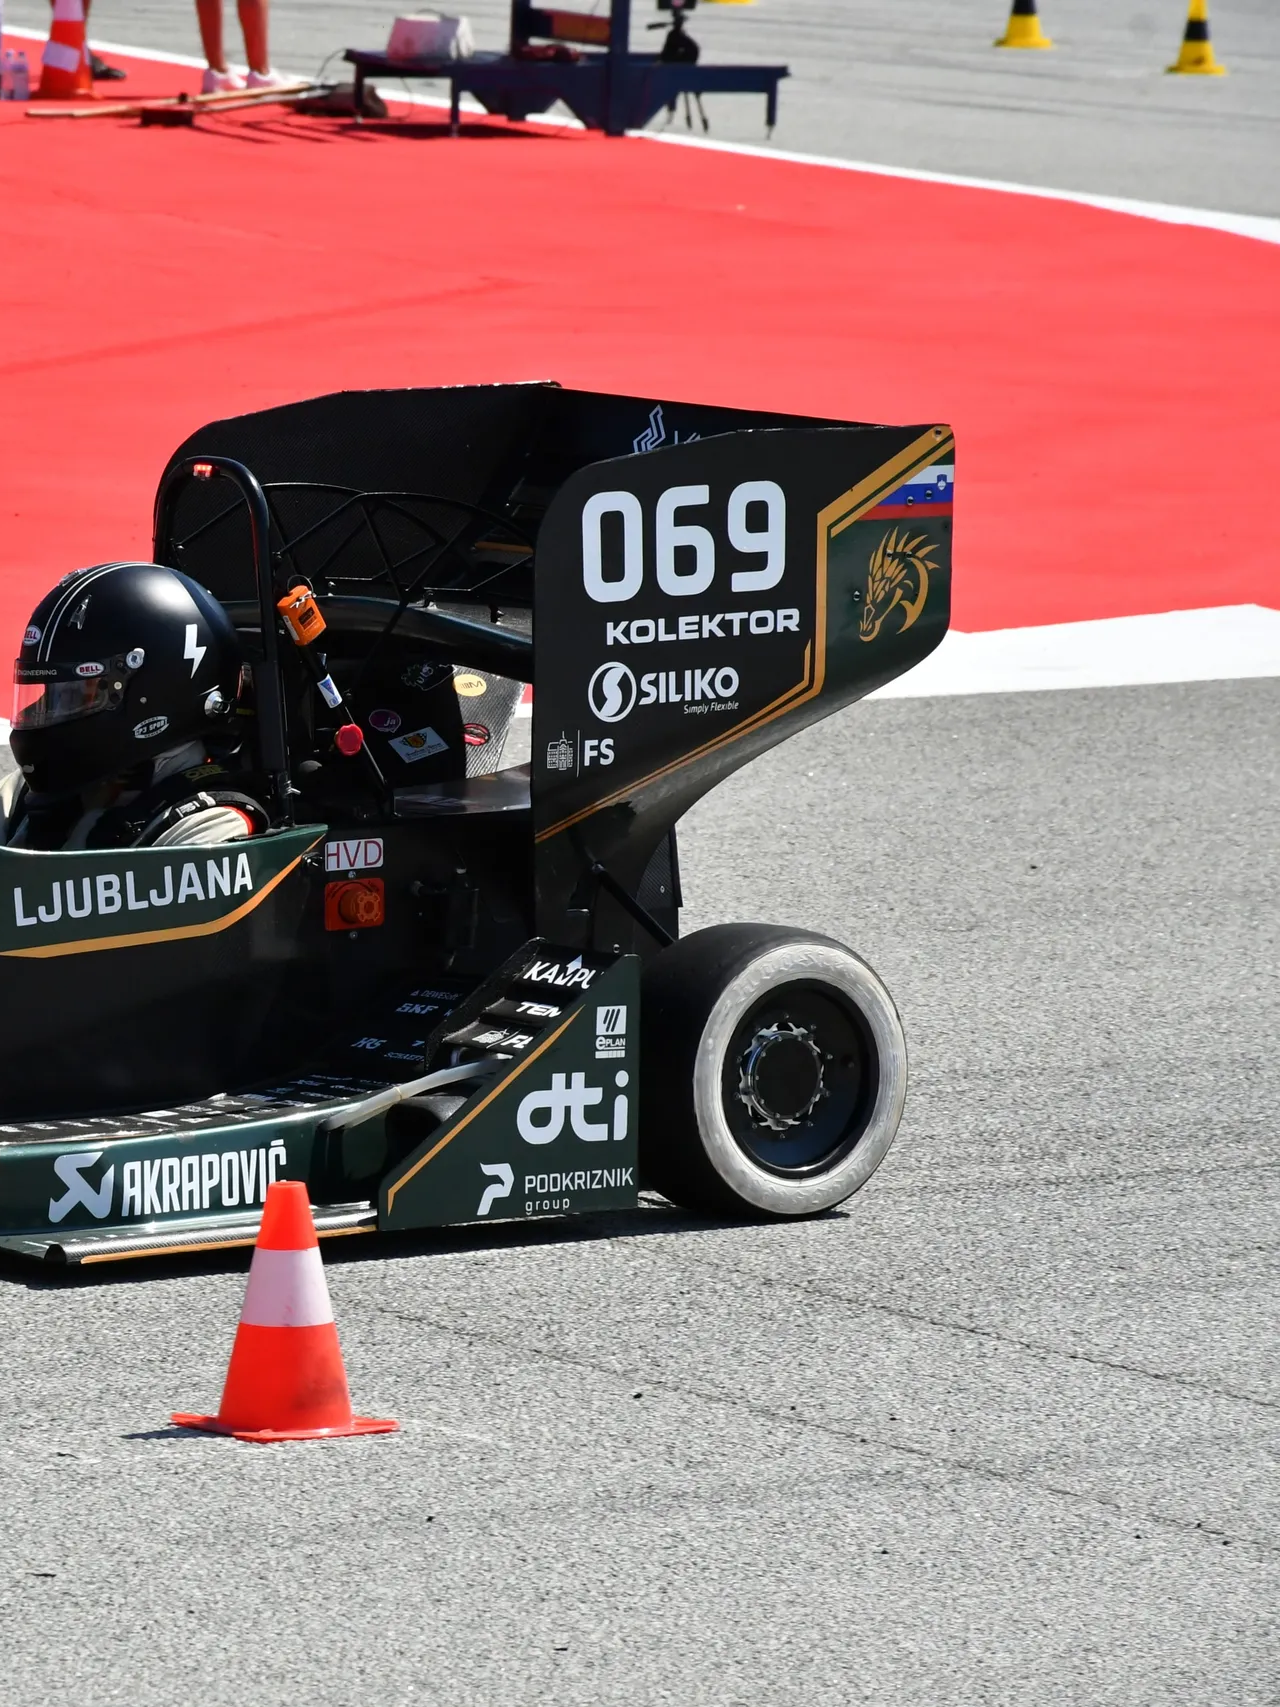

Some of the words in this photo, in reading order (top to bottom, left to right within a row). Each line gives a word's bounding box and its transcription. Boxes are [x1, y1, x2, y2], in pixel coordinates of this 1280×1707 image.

[581, 480, 787, 603] 069
[606, 608, 800, 646] KOLEKTOR
[79, 665, 101, 673] BELL
[638, 666, 740, 705] SILIKO
[683, 703, 709, 715] Simply
[710, 700, 739, 711] Flexible
[583, 738, 615, 766] FS
[326, 839, 383, 870] HVD
[13, 852, 253, 927] LJUBLJANA
[395, 1002, 439, 1015] SKF
[516, 1070, 630, 1145] dti
[524, 1167, 634, 1195] PODKRIZNIK
[525, 1198, 570, 1215] group
